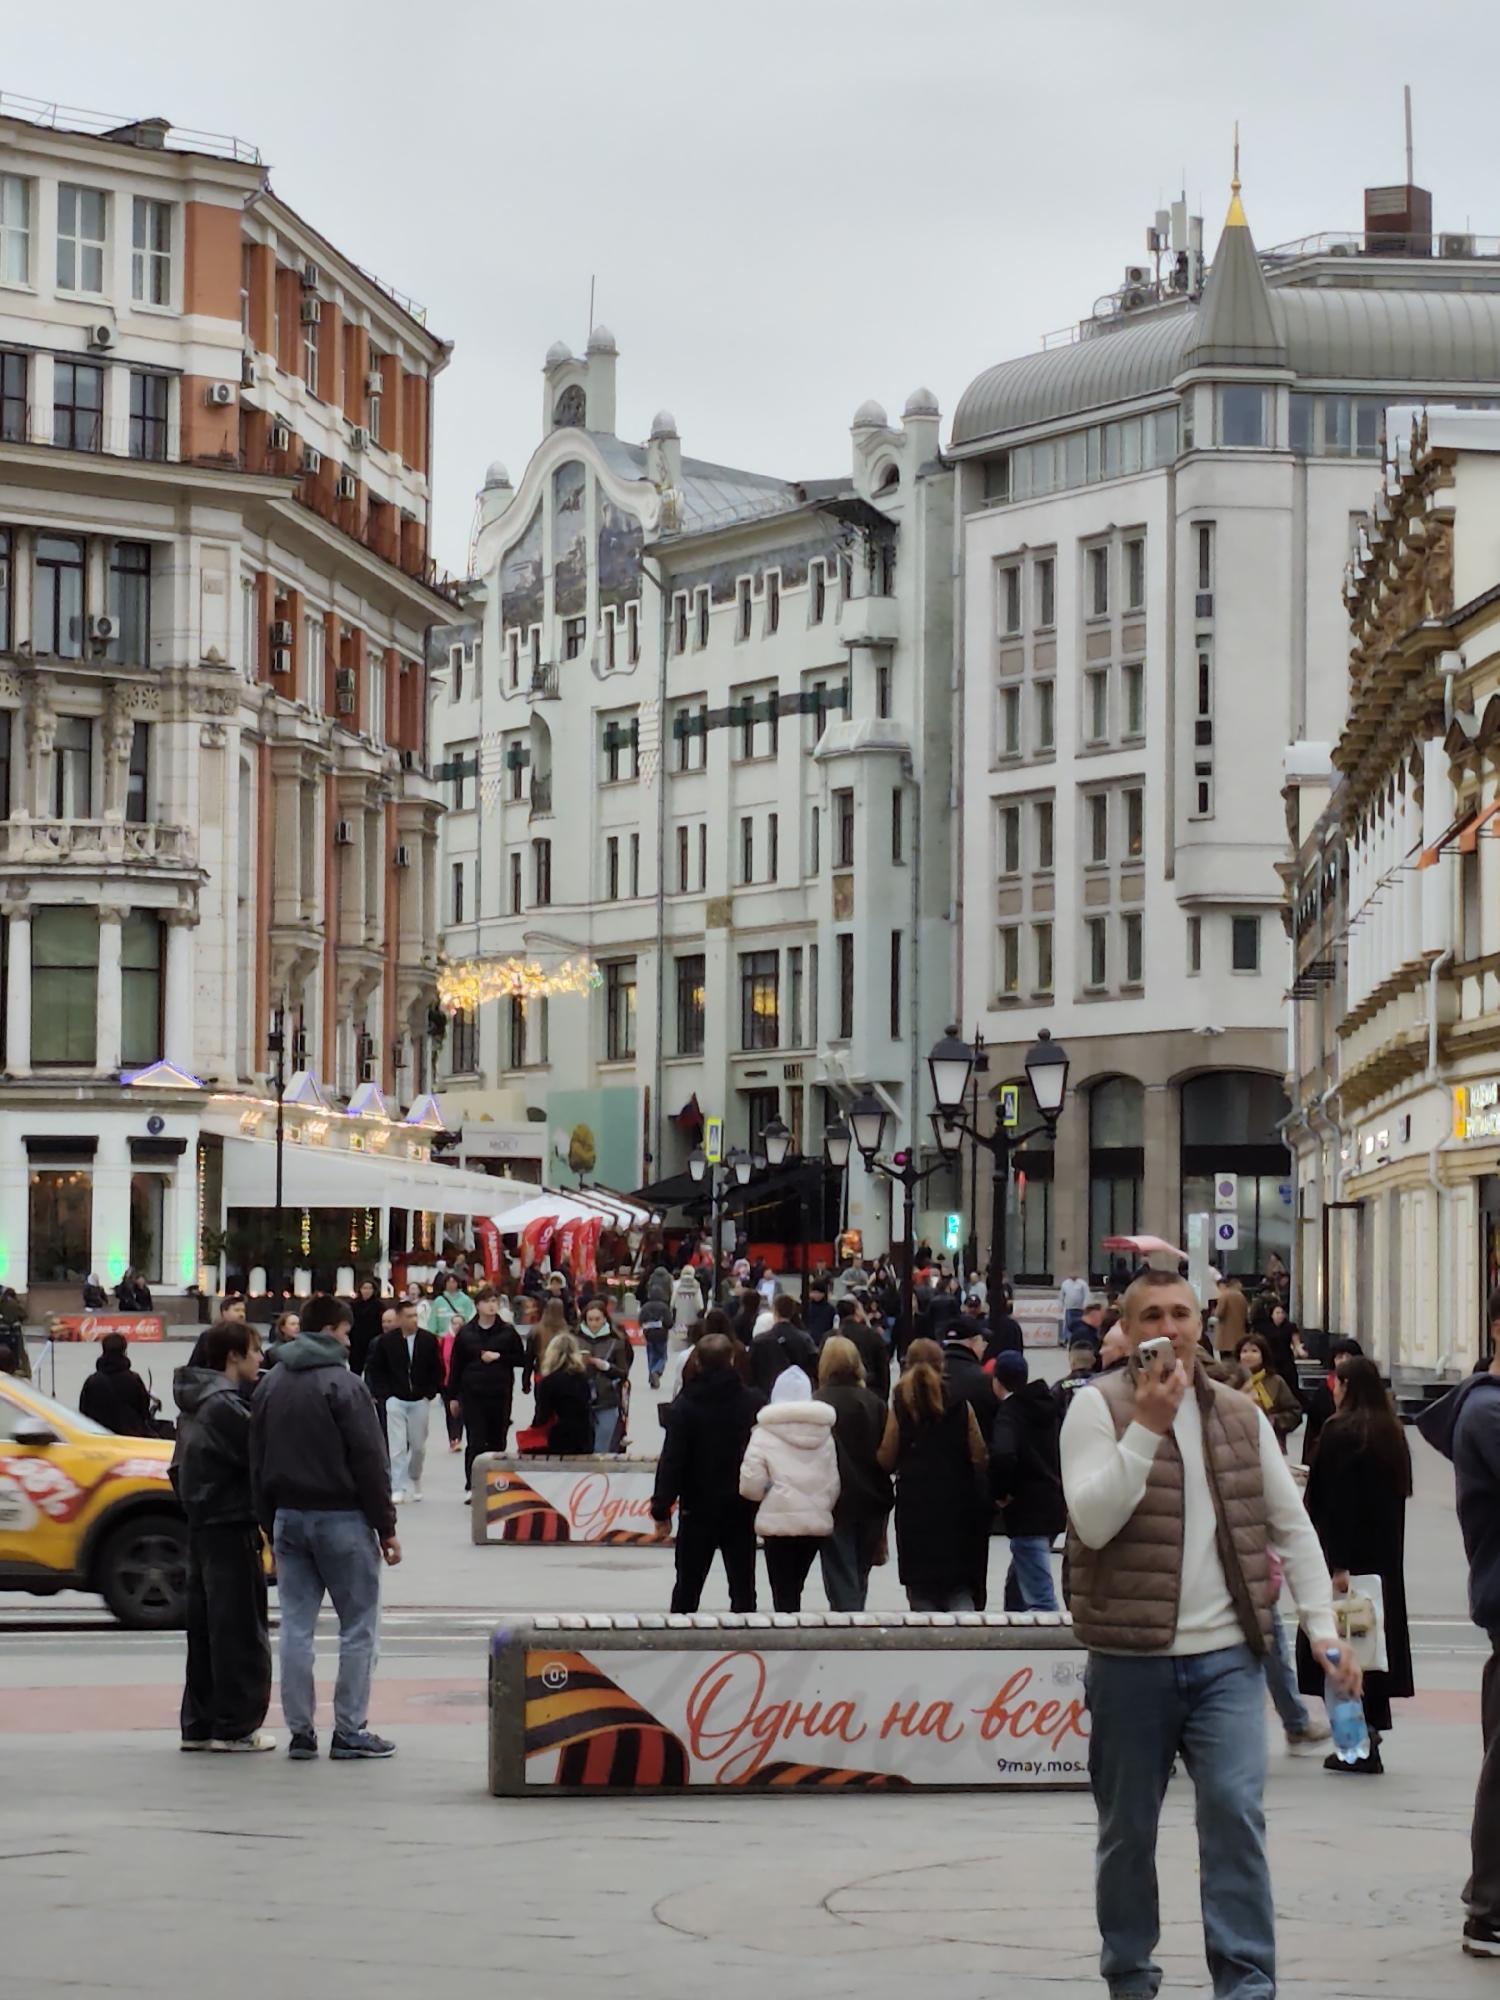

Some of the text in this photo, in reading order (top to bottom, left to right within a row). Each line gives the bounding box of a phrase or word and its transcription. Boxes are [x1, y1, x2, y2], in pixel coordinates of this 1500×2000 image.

[569, 1472, 653, 1541] Одна
[686, 1650, 1091, 1785] Одна на всех
[997, 1757, 1090, 1776] 9may.mos.
